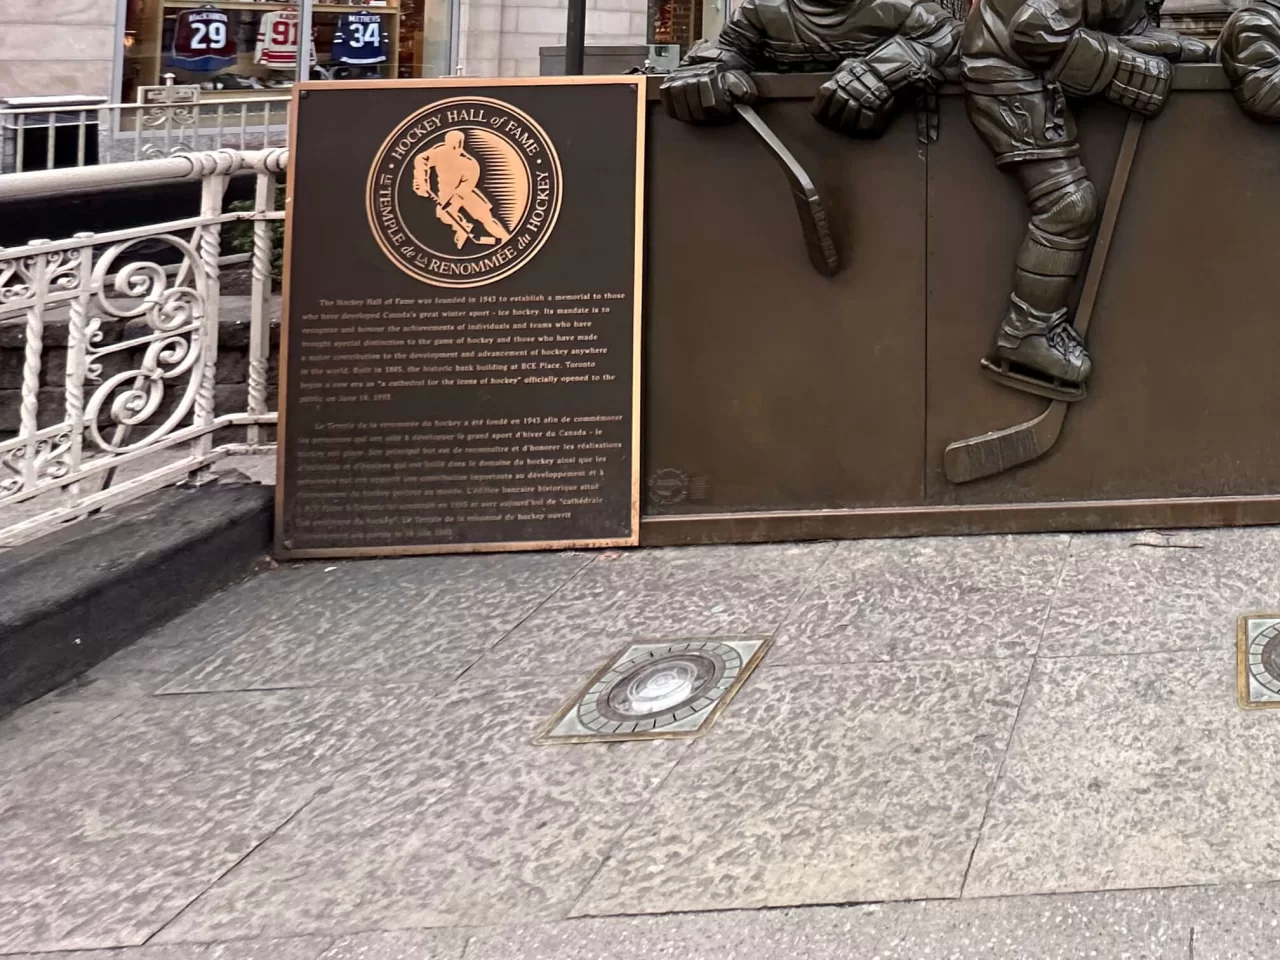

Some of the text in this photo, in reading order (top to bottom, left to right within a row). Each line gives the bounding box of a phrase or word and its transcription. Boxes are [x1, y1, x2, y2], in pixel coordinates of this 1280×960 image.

[190, 22, 227, 49] 29
[272, 20, 300, 46] 91
[349, 22, 380, 48] 34
[391, 109, 541, 160] HOCKEY HALL of FAME
[379, 186, 402, 246] TEMPLE
[400, 244, 417, 258] de
[415, 252, 429, 268] LA
[429, 247, 518, 276] RENOMMÉE
[516, 234, 533, 250] du
[528, 170, 550, 235] HOCKEY
